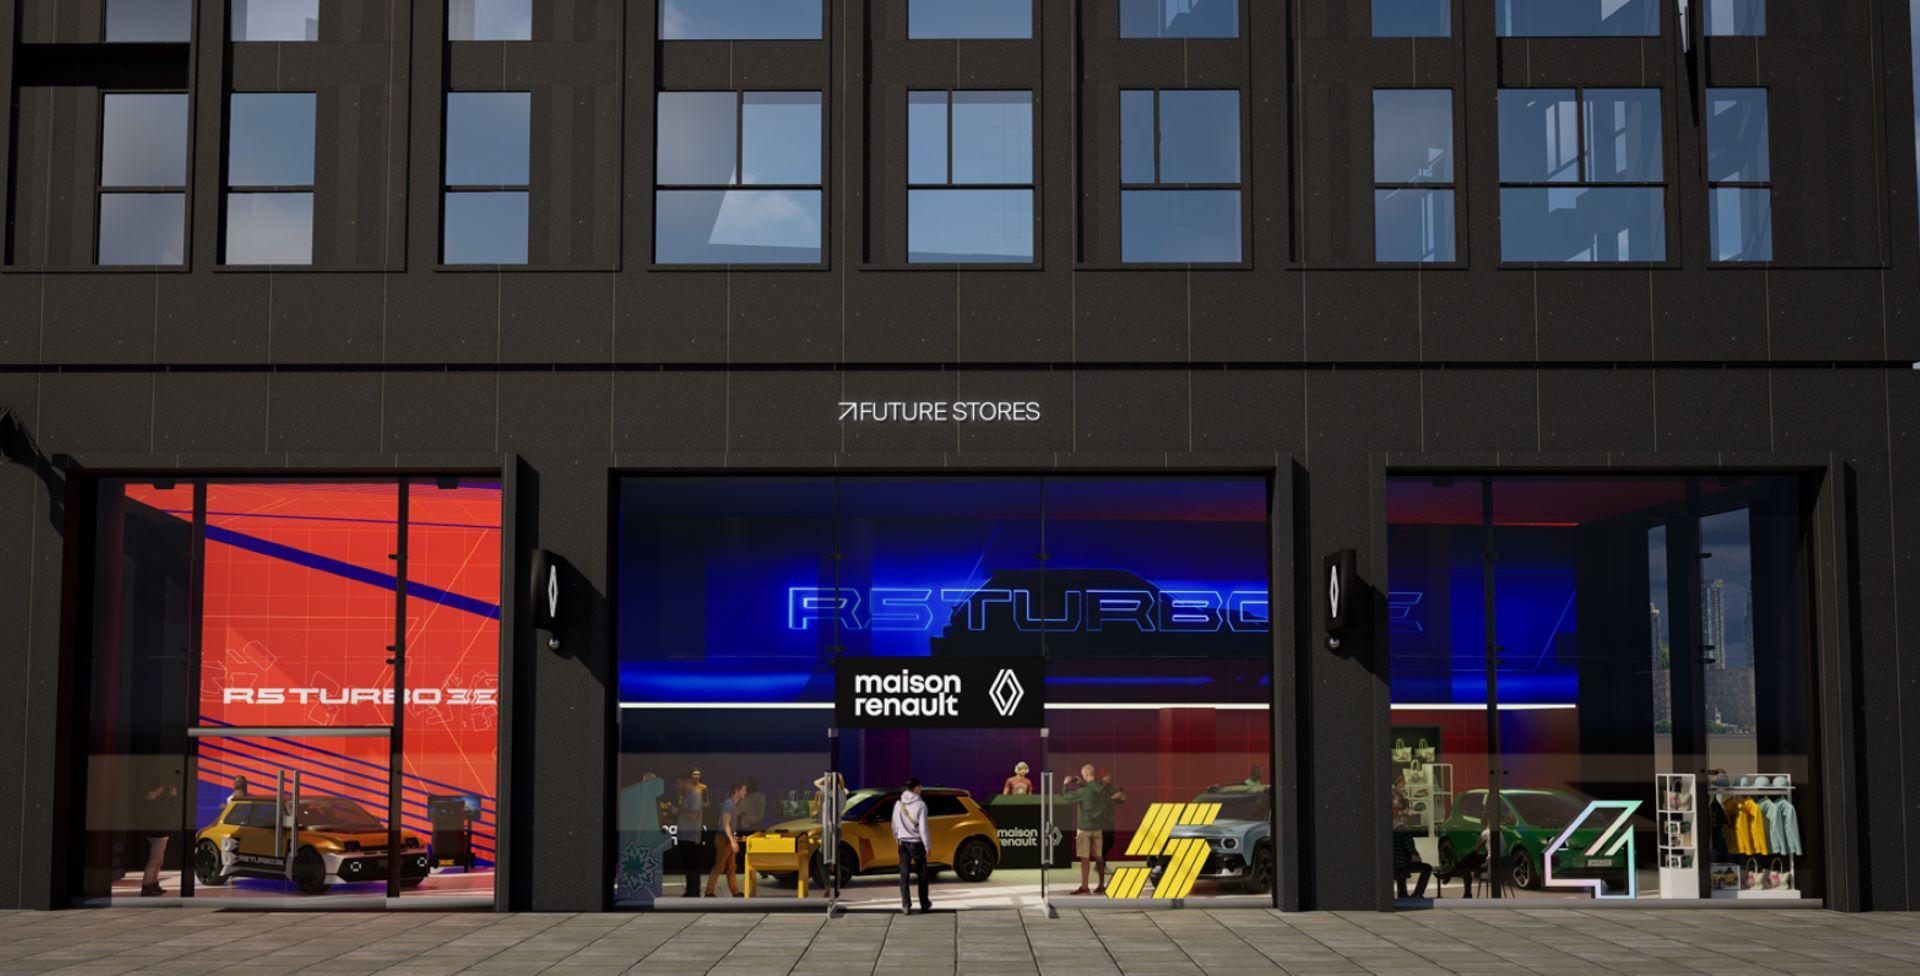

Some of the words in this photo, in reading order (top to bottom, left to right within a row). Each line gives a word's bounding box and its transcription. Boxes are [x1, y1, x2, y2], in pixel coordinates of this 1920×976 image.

[861, 401, 948, 422] FUTURE
[951, 401, 1041, 422] STORES
[854, 669, 962, 693] maison
[854, 692, 959, 717] renault
[996, 826, 1039, 837] maison
